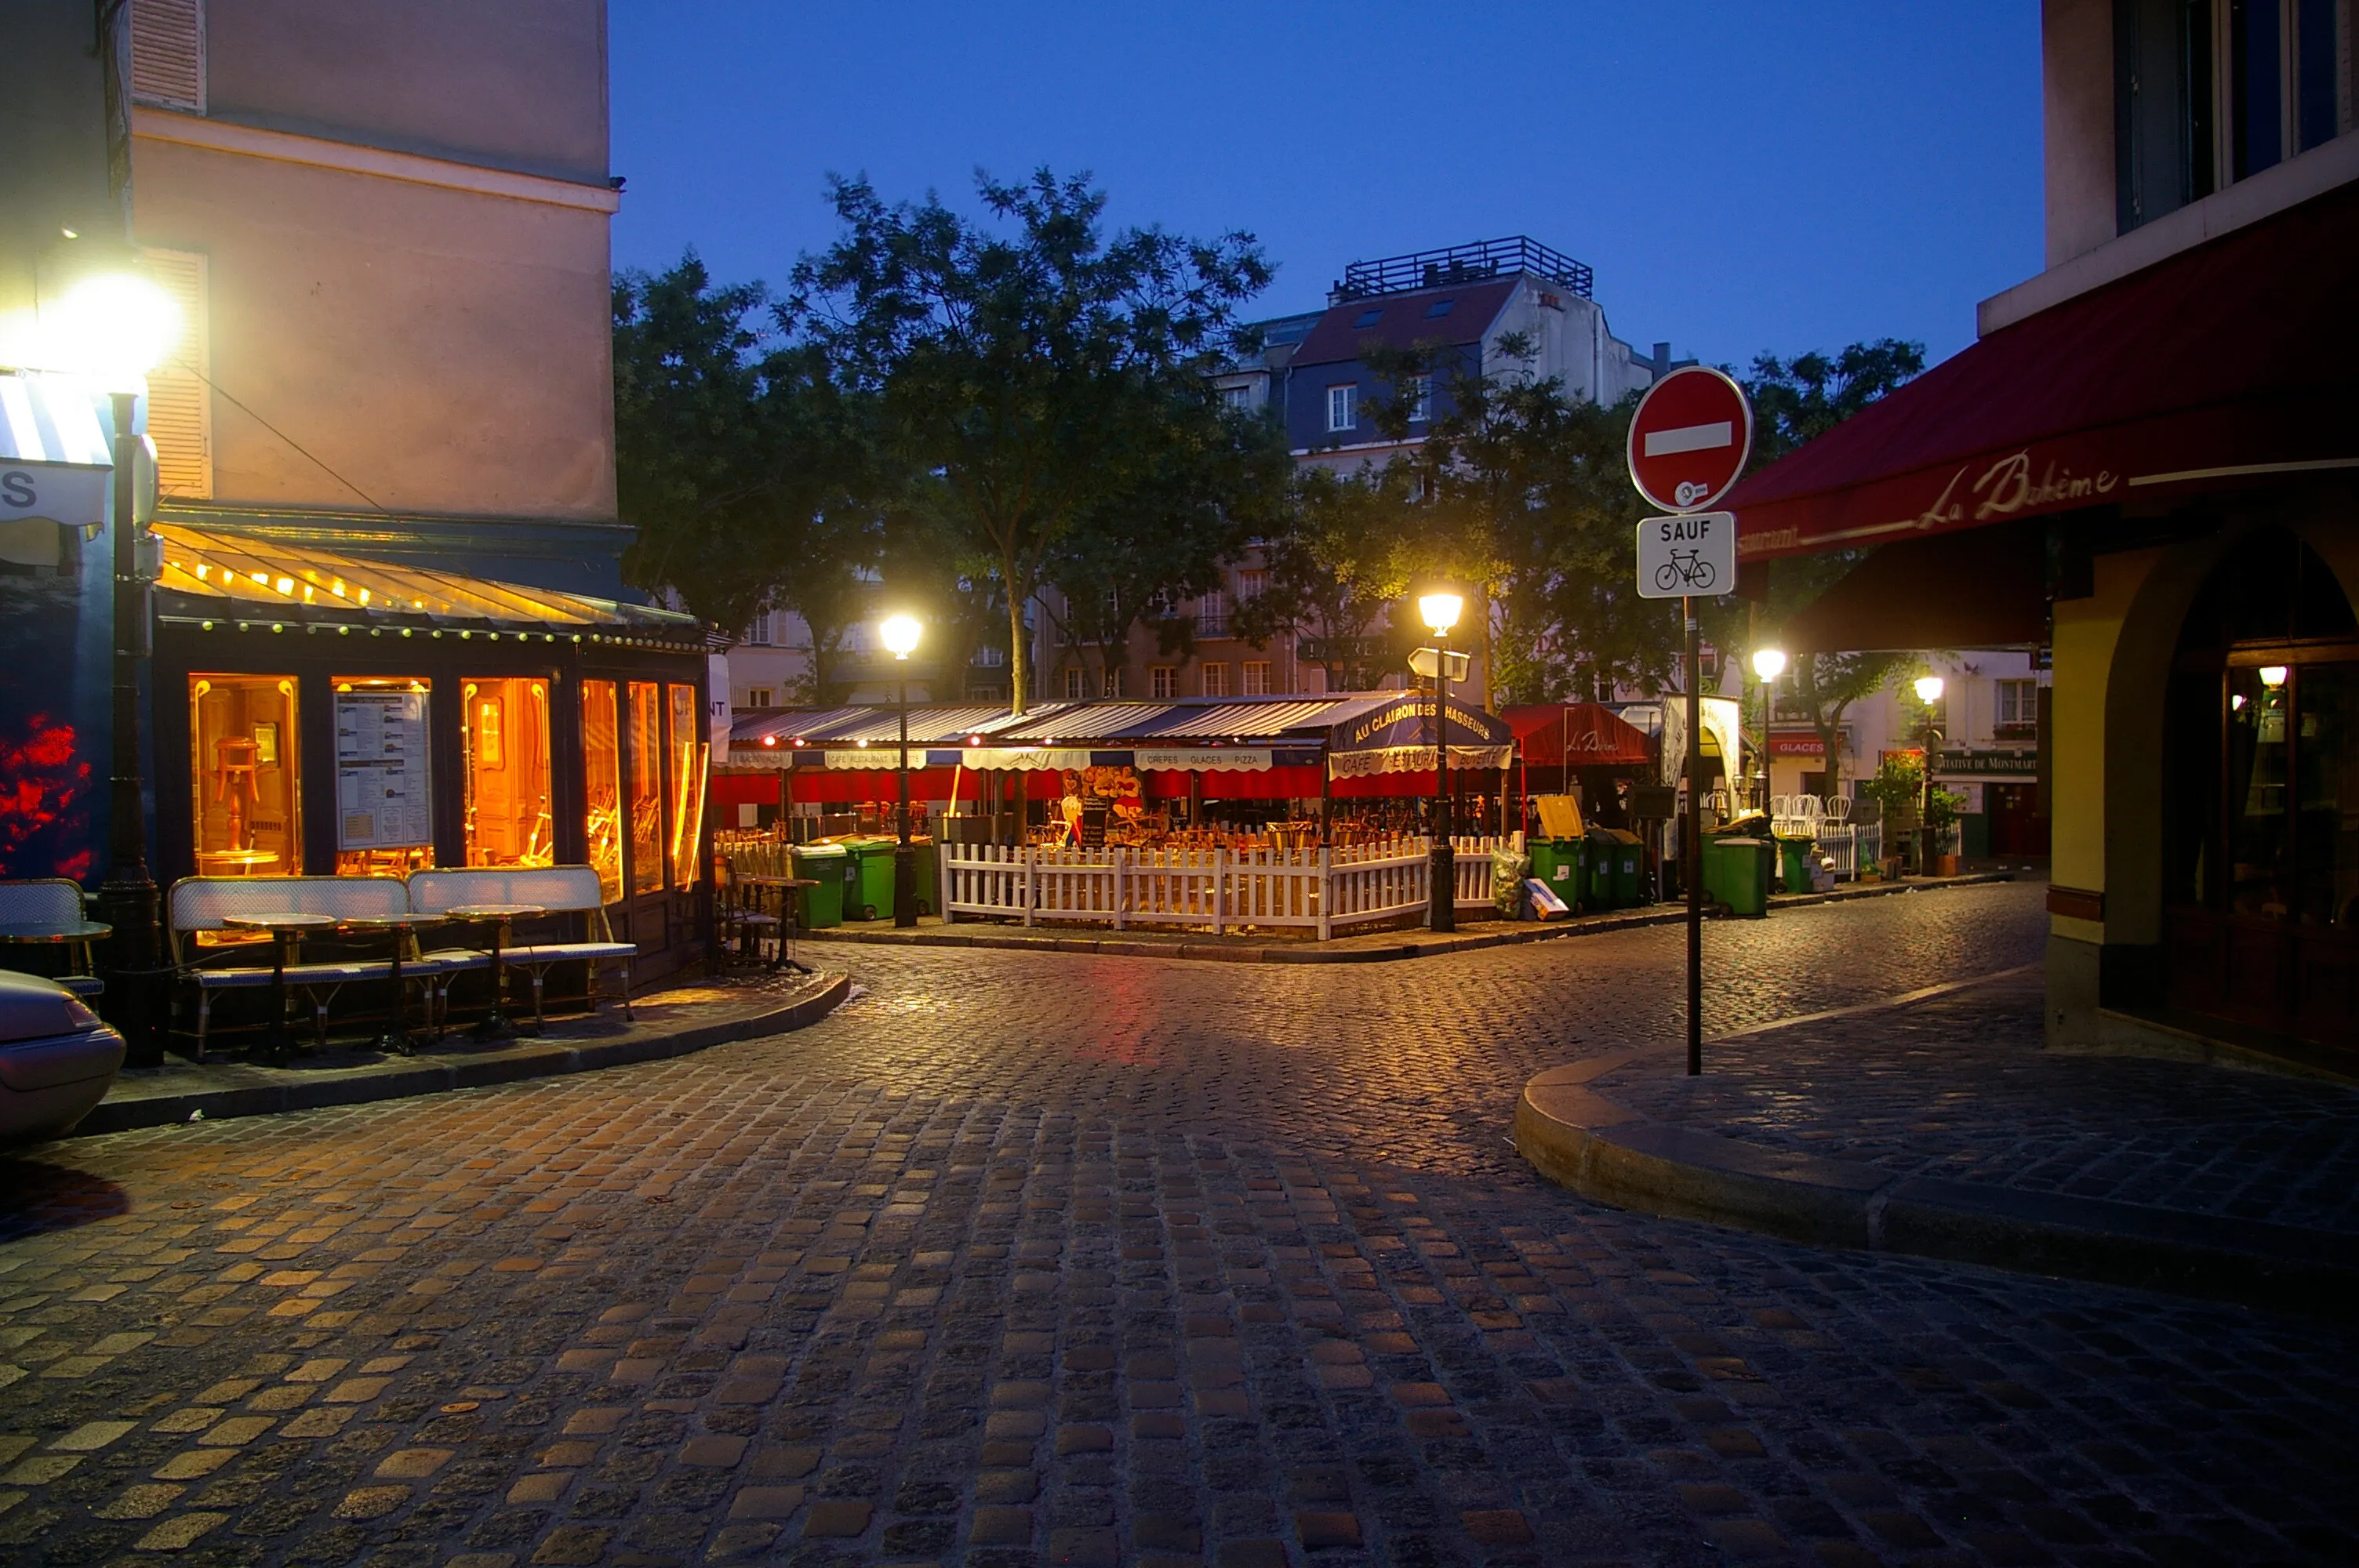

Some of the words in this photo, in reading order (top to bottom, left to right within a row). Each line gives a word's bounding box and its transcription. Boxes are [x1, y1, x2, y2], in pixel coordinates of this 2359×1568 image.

[1917, 464, 1969, 530] La
[1660, 521, 1710, 542] SAUF
[1355, 727, 1370, 744] AU
[1372, 703, 1416, 732] CLAIRON
[1418, 703, 1437, 717] DES
[1445, 707, 1491, 741] HASSEURS
[1779, 743, 1825, 753] GLACES
[1147, 755, 1179, 764] CREPES
[1190, 755, 1223, 764] GLACES
[1234, 755, 1258, 764] PIZZA
[1975, 759, 1986, 768] DE
